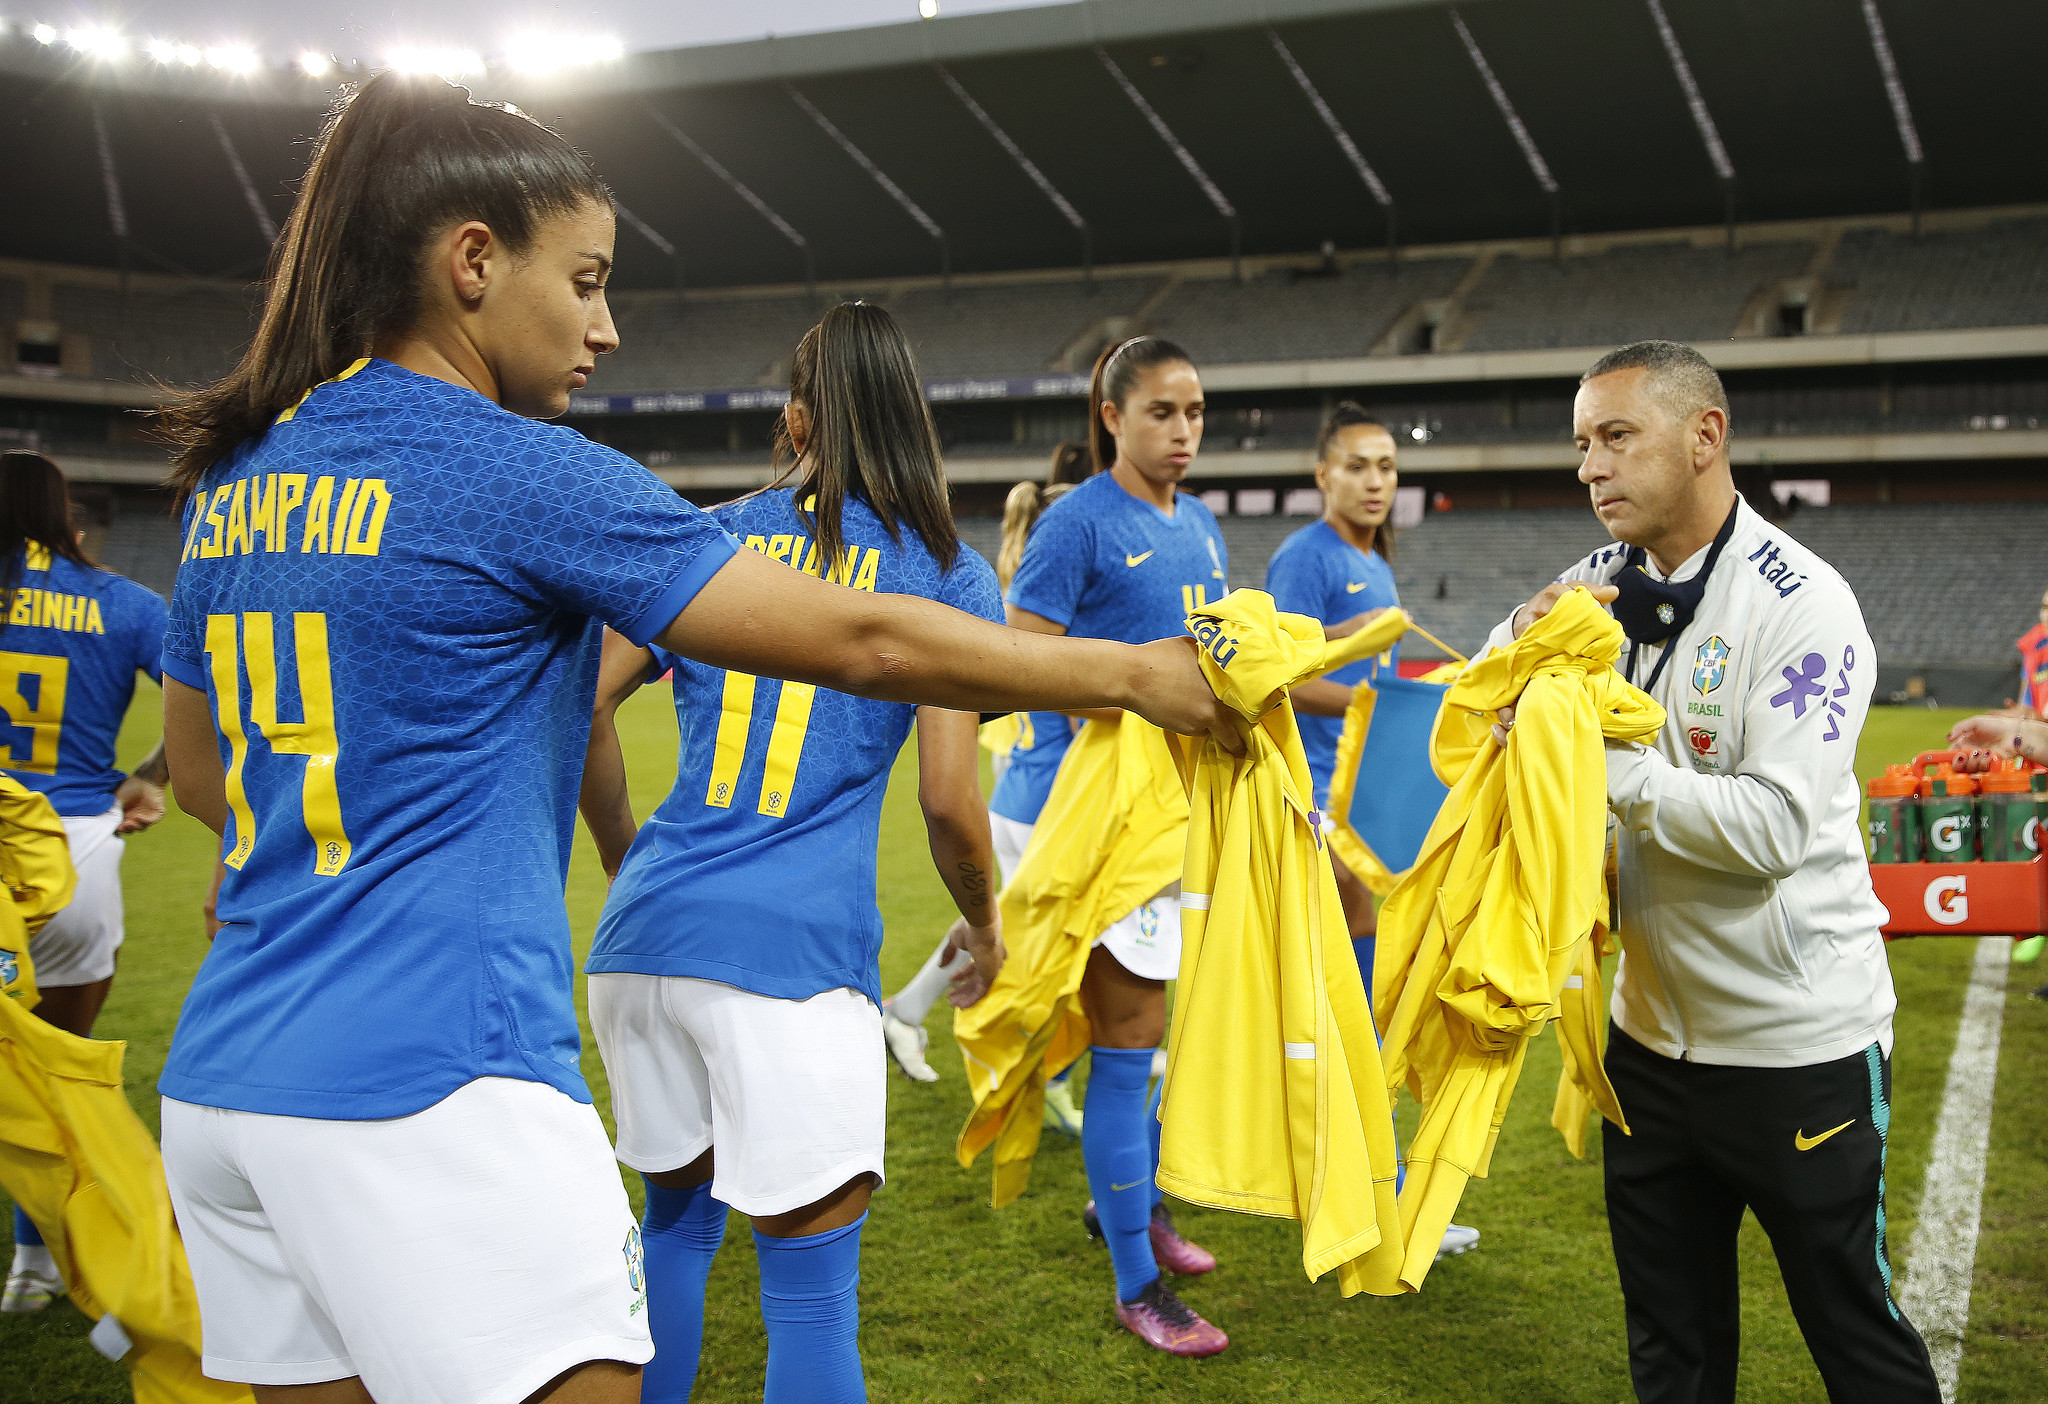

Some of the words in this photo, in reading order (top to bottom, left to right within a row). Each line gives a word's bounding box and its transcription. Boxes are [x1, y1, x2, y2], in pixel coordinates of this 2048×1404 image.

[1748, 540, 1808, 598] Itaú
[0, 650, 70, 776] 9
[1687, 702, 1725, 717] BRASIL
[1823, 644, 1855, 742] vivo
[203, 612, 351, 876] 14
[1924, 875, 1968, 926] G
